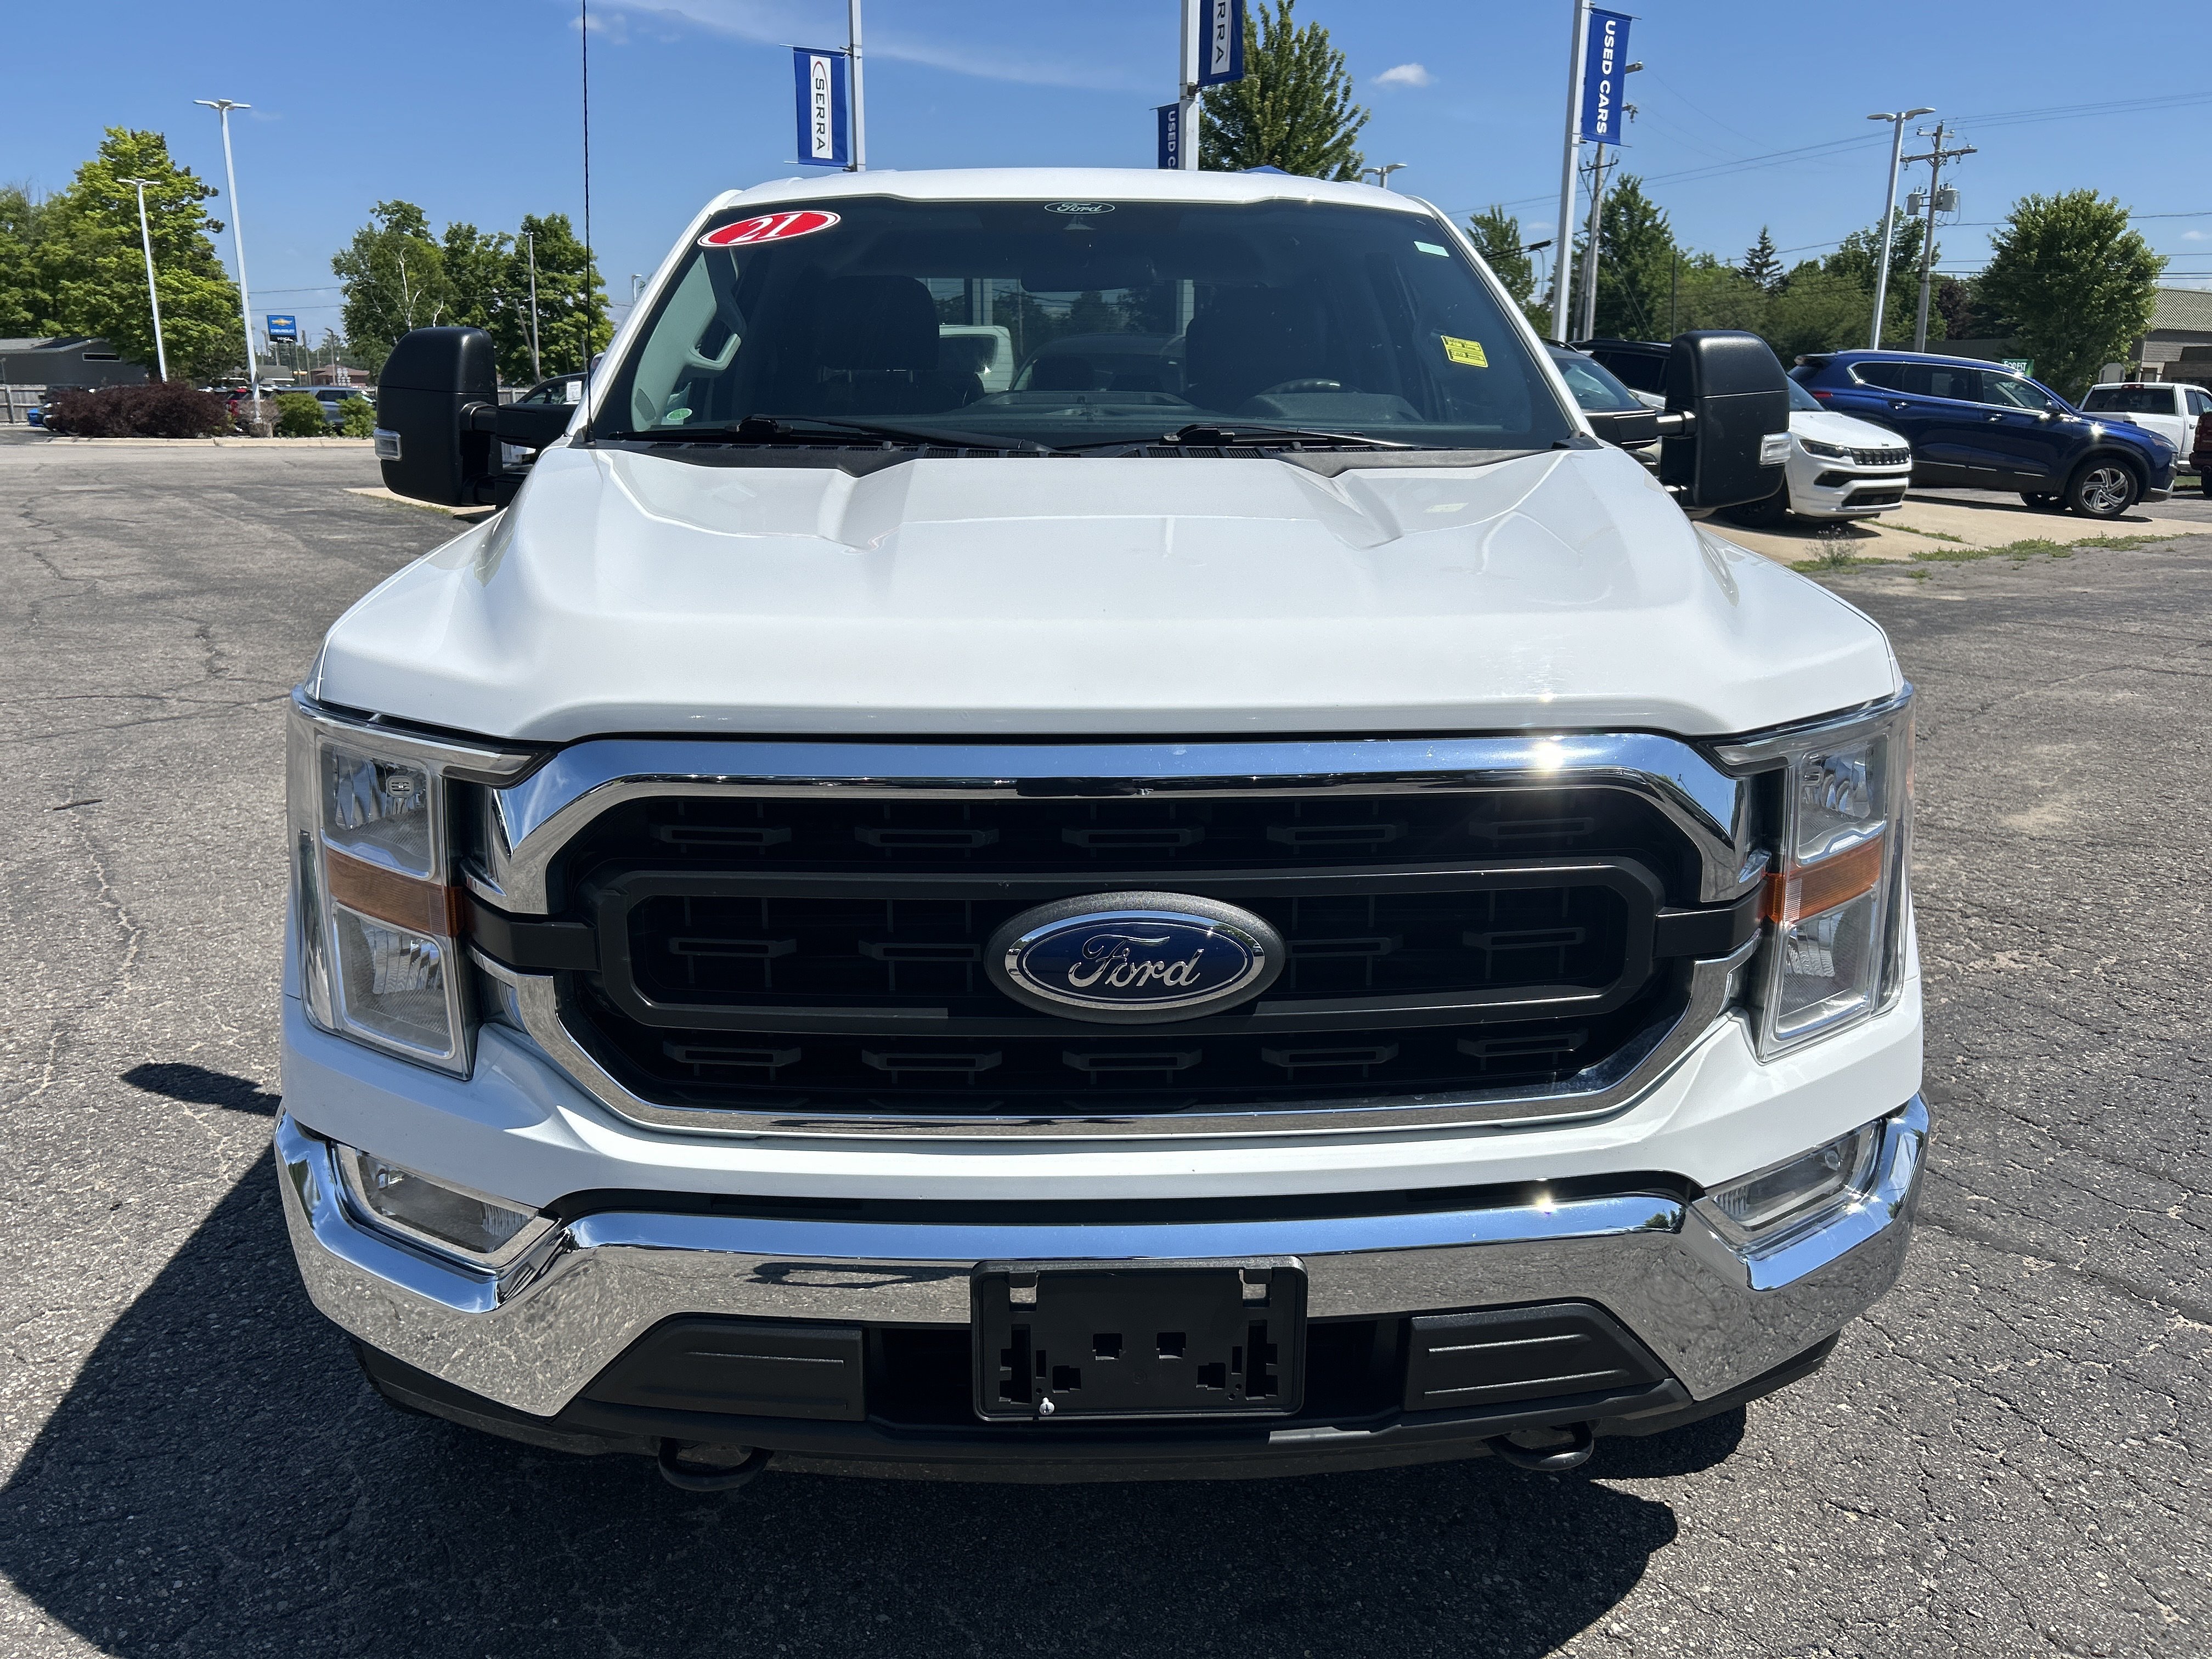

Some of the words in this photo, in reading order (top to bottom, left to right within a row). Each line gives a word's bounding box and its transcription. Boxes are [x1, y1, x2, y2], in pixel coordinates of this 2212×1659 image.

[1602, 20, 1616, 75] USED
[816, 78, 825, 150] SERRA
[1596, 80, 1611, 134] CARS
[727, 213, 804, 244] 21
[1057, 203, 1102, 212] Ford
[1068, 934, 1204, 987] Ford
